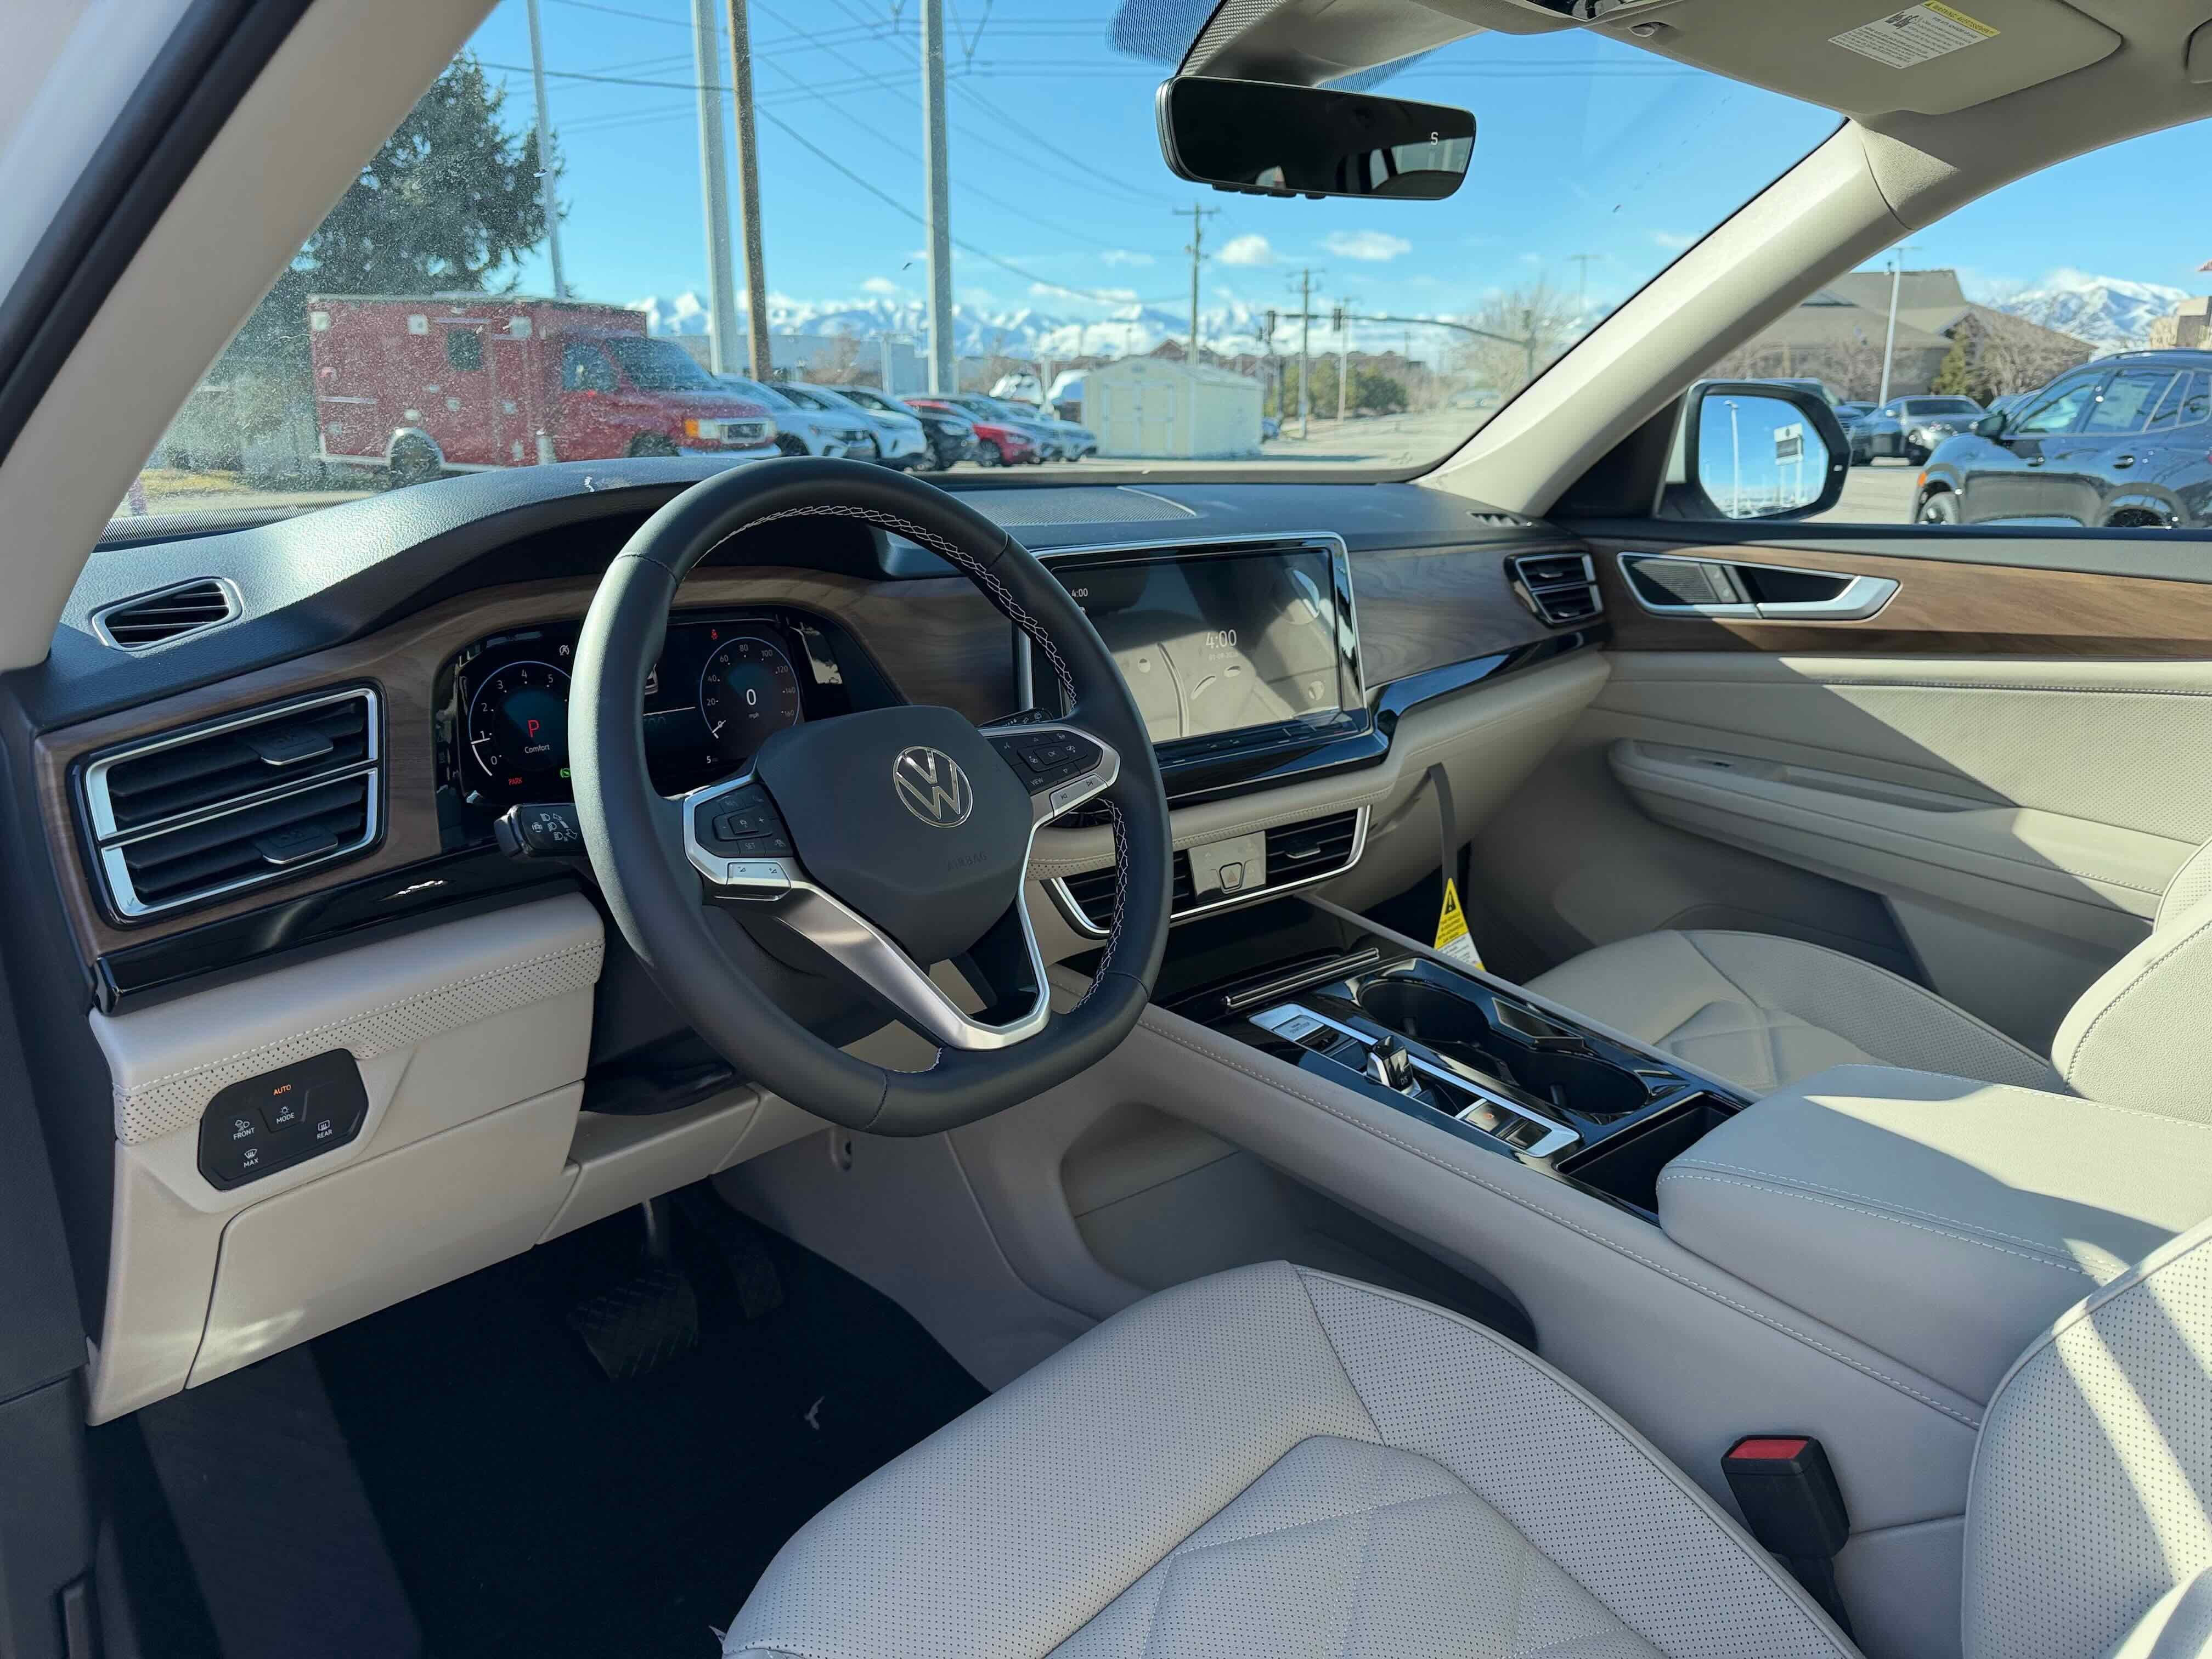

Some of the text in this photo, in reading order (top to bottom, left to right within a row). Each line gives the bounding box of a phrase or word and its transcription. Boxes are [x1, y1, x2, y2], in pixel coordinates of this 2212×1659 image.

[1431, 132, 1438, 145] S
[1071, 588, 1088, 598] 4:00
[1206, 629, 1237, 649] 4:00
[761, 649, 773, 657] 100
[522, 669, 527, 678] 4
[548, 674, 554, 683] 5
[496, 680, 503, 689] 3
[707, 698, 715, 706] 20
[746, 689, 757, 706] 0
[482, 703, 488, 712] 2
[527, 720, 539, 738] P
[480, 731, 485, 740] 1
[524, 744, 550, 754] Comfort
[490, 756, 498, 765] 0
[948, 851, 987, 872] AIRBAG
[273, 1084, 292, 1096] AUTO
[276, 1112, 295, 1124] MODE
[233, 1127, 255, 1141] FRONT
[317, 1129, 333, 1139] REAR
[243, 1157, 259, 1168] MAX
